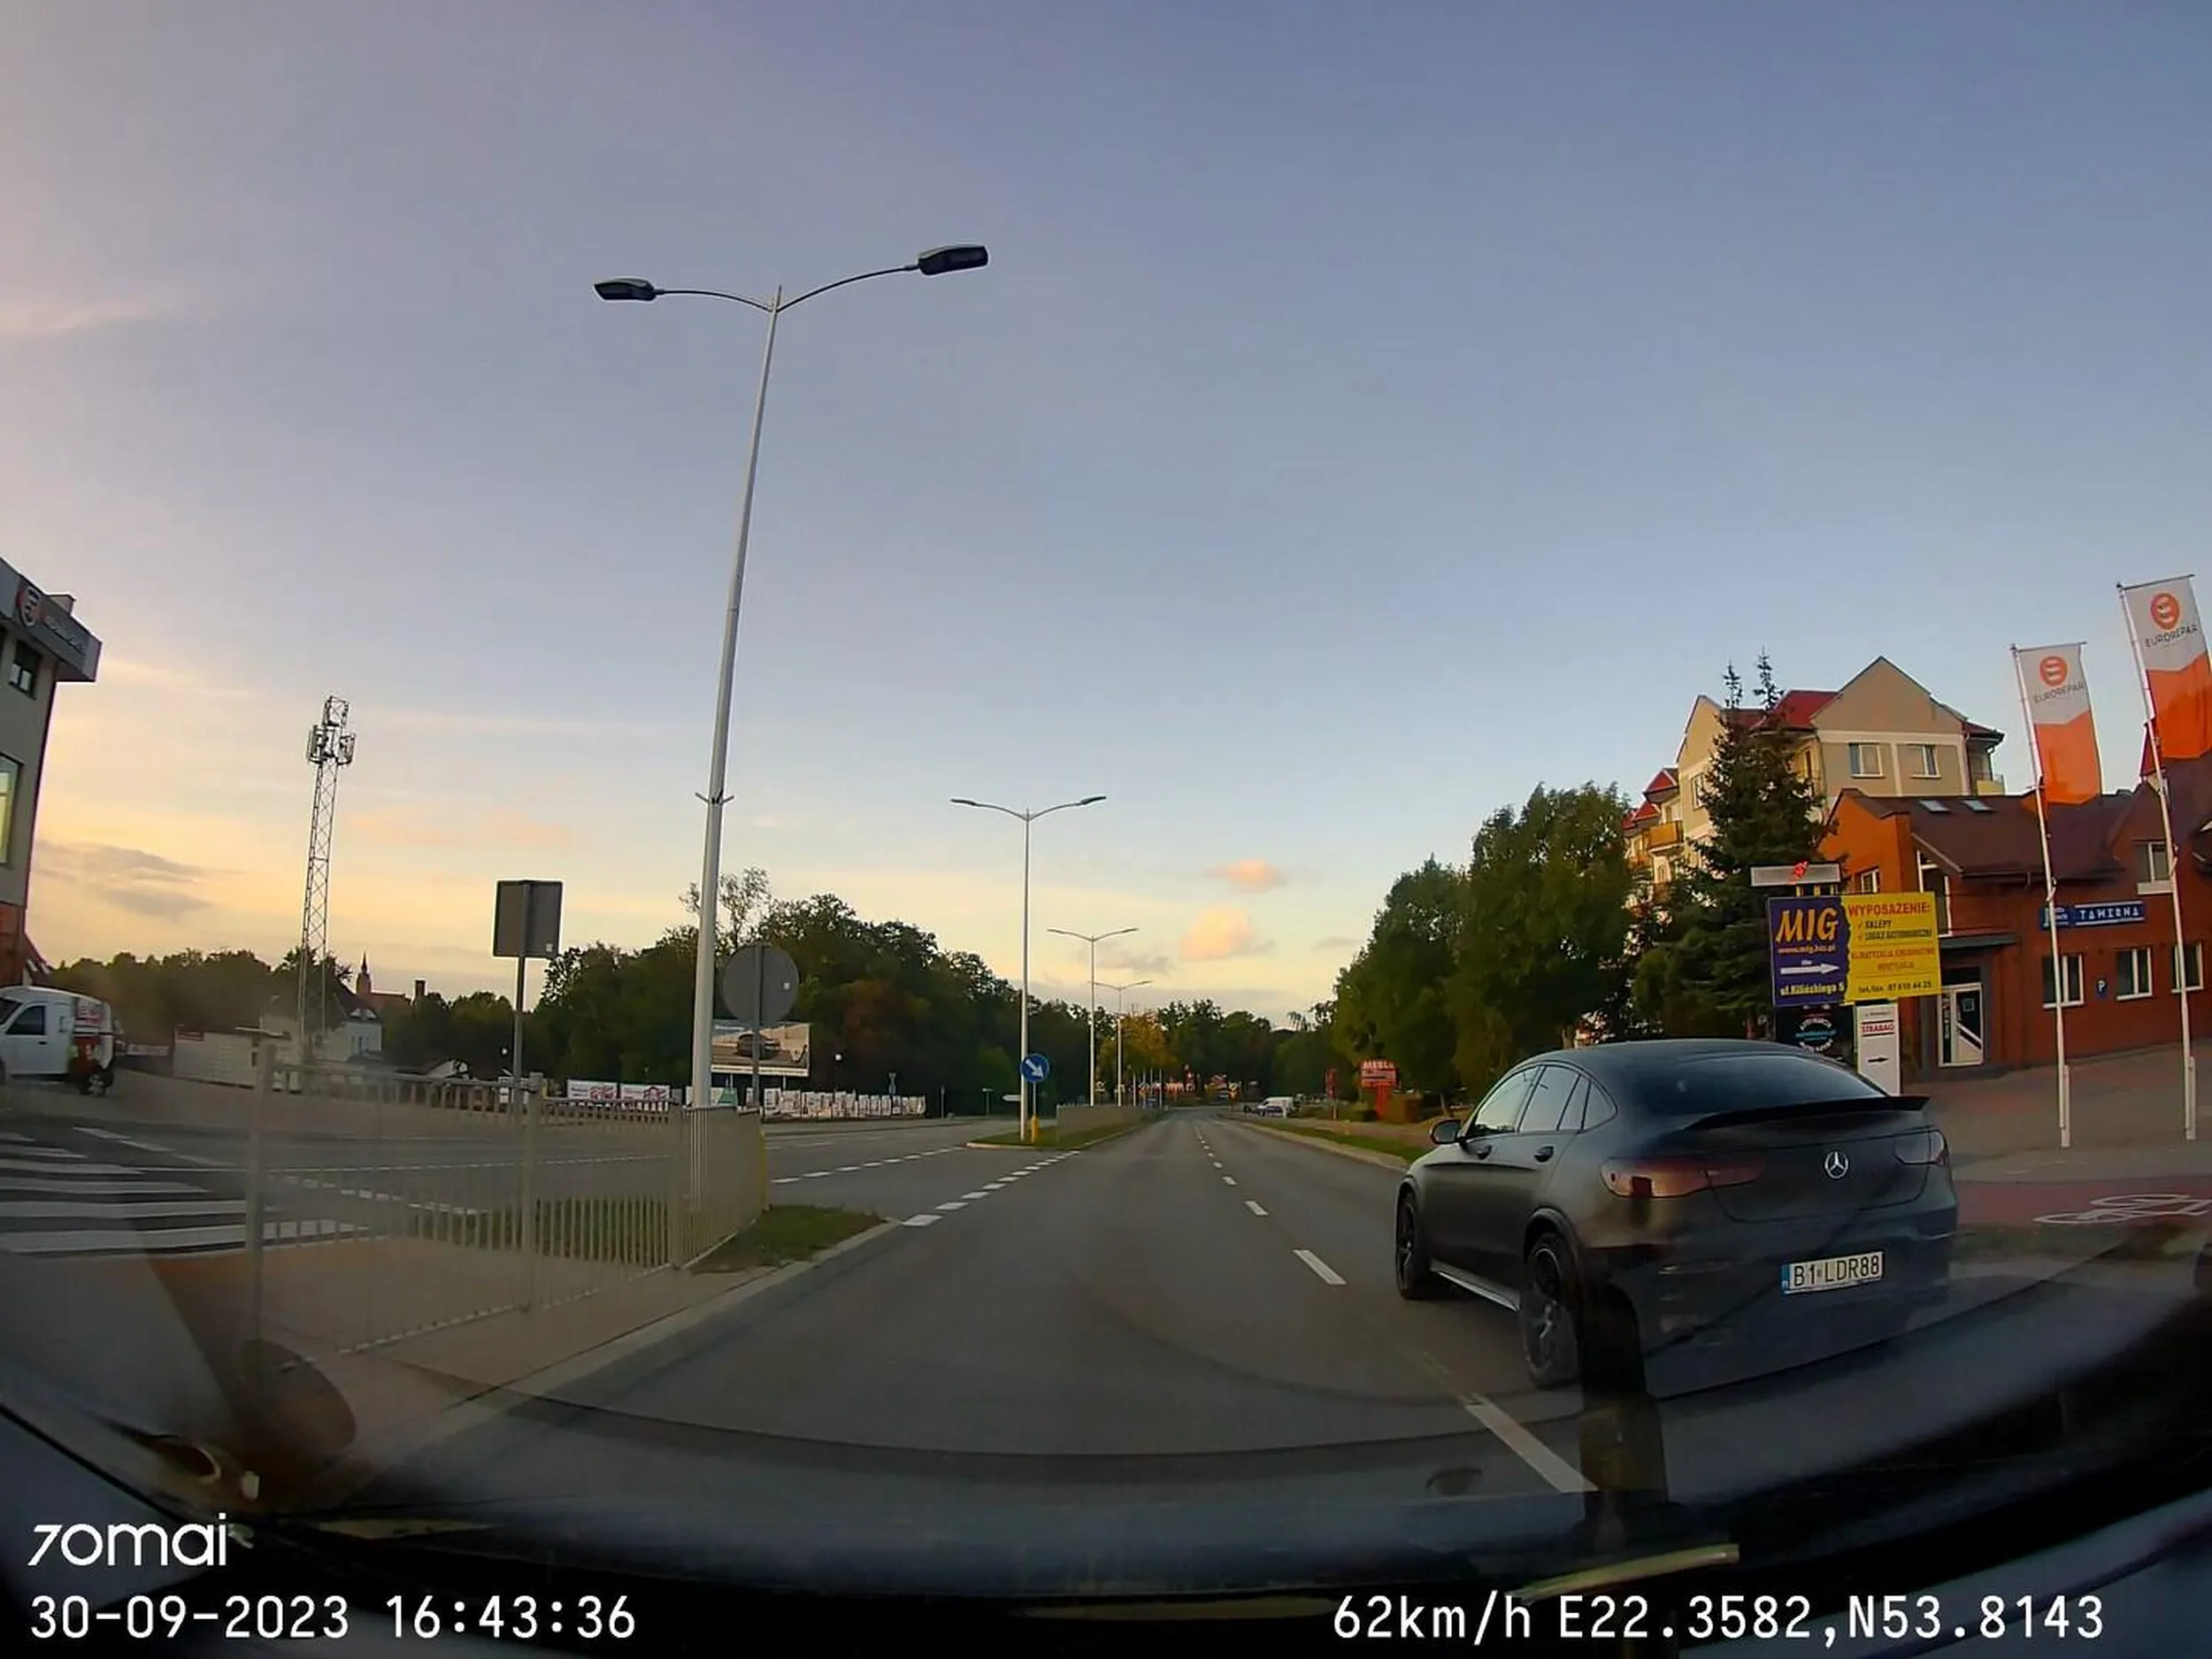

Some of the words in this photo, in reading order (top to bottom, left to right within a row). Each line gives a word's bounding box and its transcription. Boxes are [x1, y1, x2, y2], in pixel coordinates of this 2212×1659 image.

[1776, 908, 1839, 943] MIG
[1793, 1264, 1816, 1286] B1
[1824, 1255, 1879, 1282] LDR88
